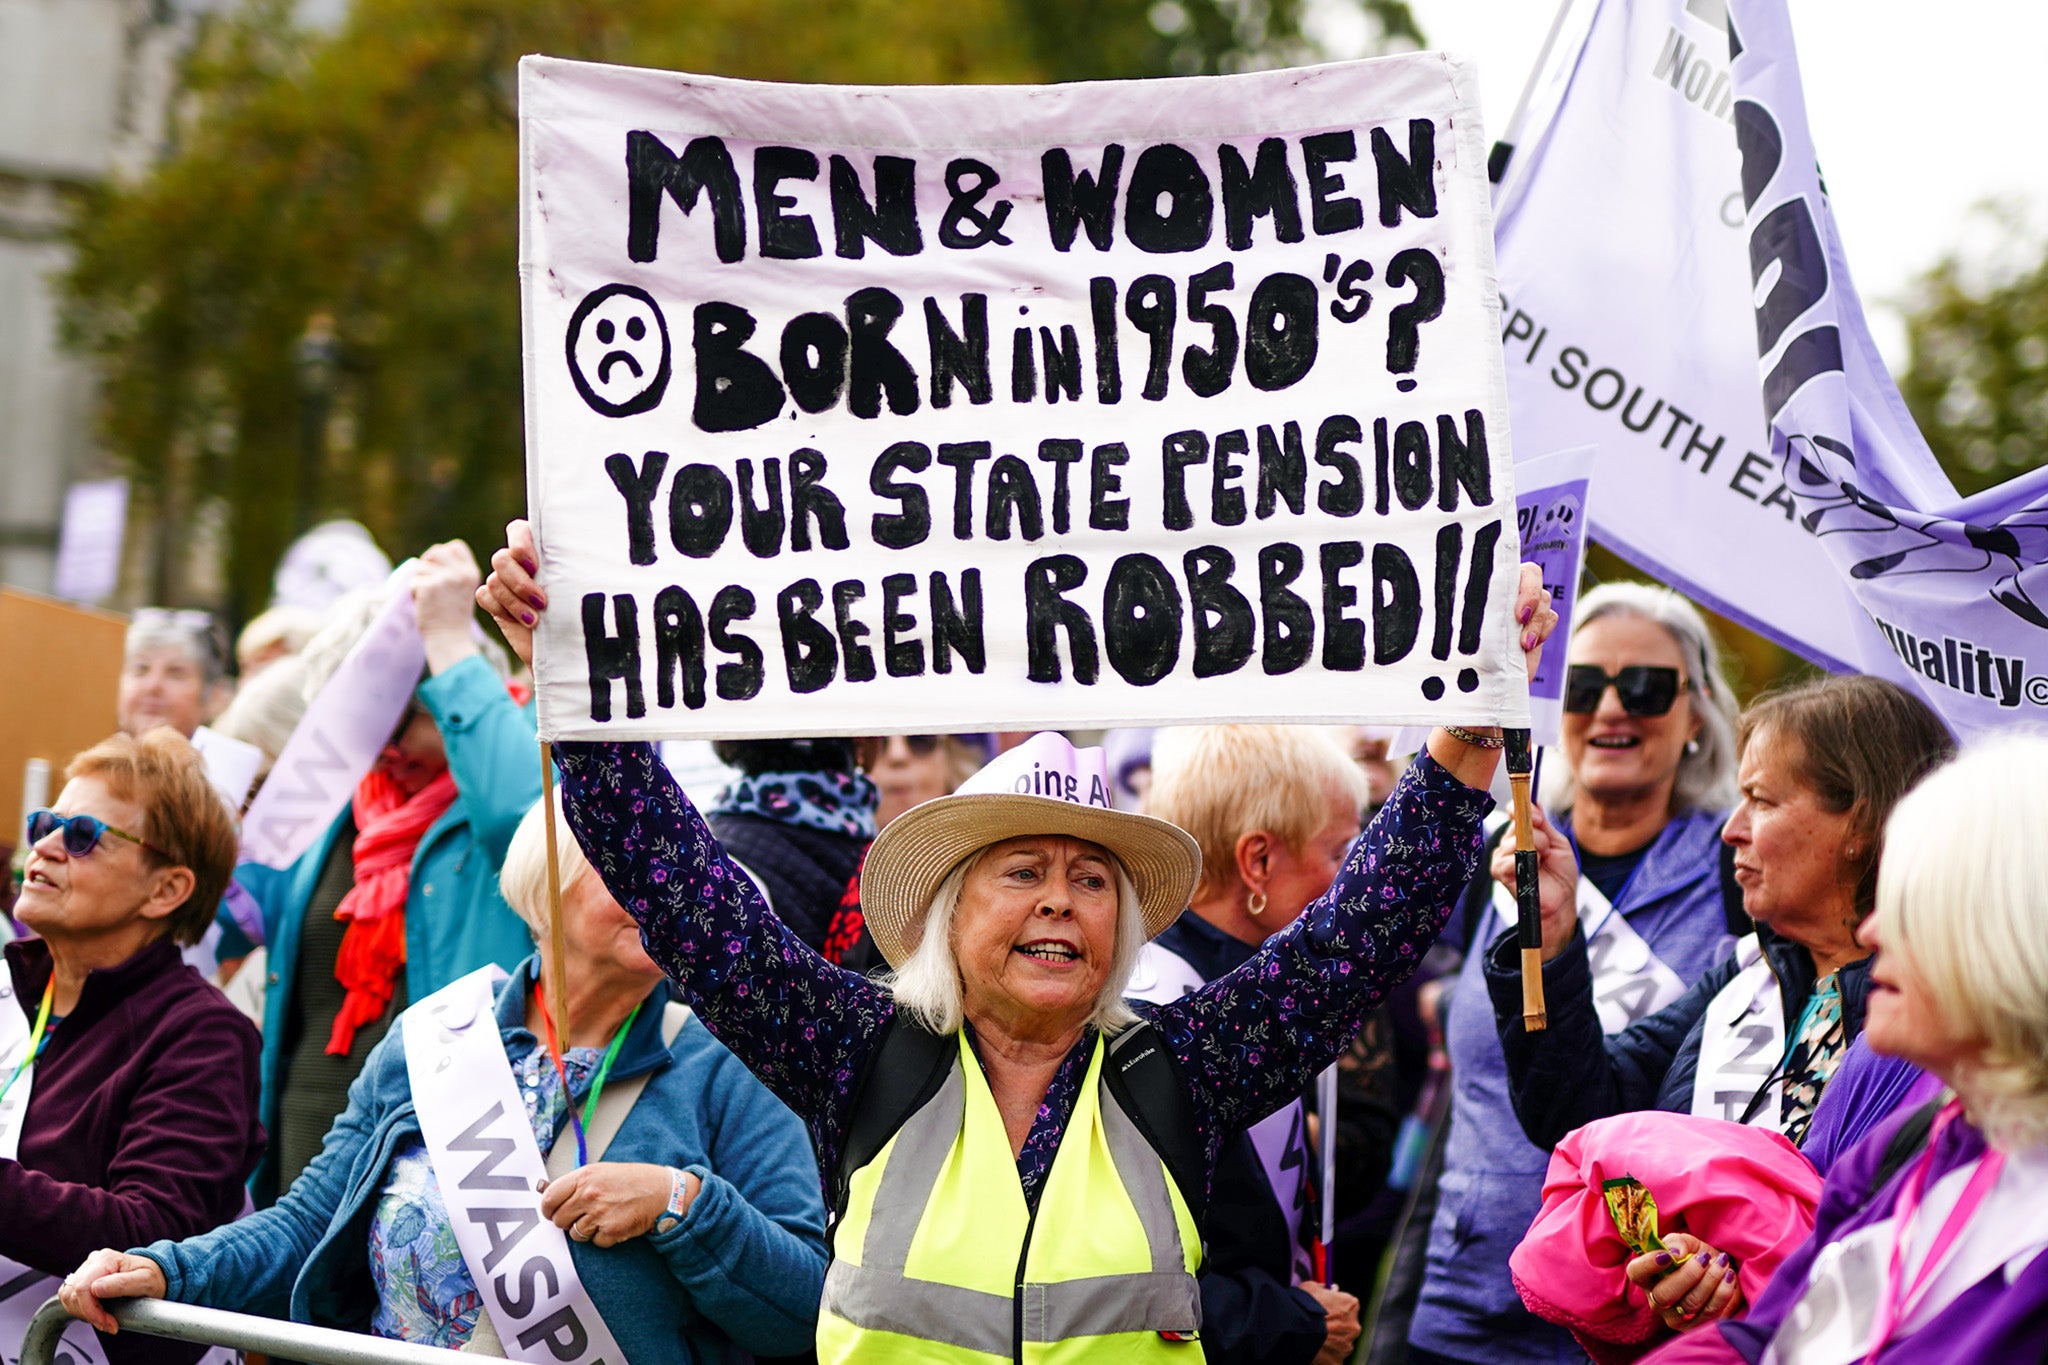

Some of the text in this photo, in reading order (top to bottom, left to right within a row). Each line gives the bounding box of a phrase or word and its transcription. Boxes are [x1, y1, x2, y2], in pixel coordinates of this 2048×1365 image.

[625, 119, 1438, 263] MEN & WOMEN
[692, 287, 993, 432] BORN
[1499, 291, 1816, 535] PI SOUTH EA
[604, 409, 1494, 566] YOUR STATE PENSION
[582, 519, 1501, 723] HAS BEEN ROBBED!!
[1089, 774, 1111, 808] A
[446, 1100, 613, 1365] WASP
